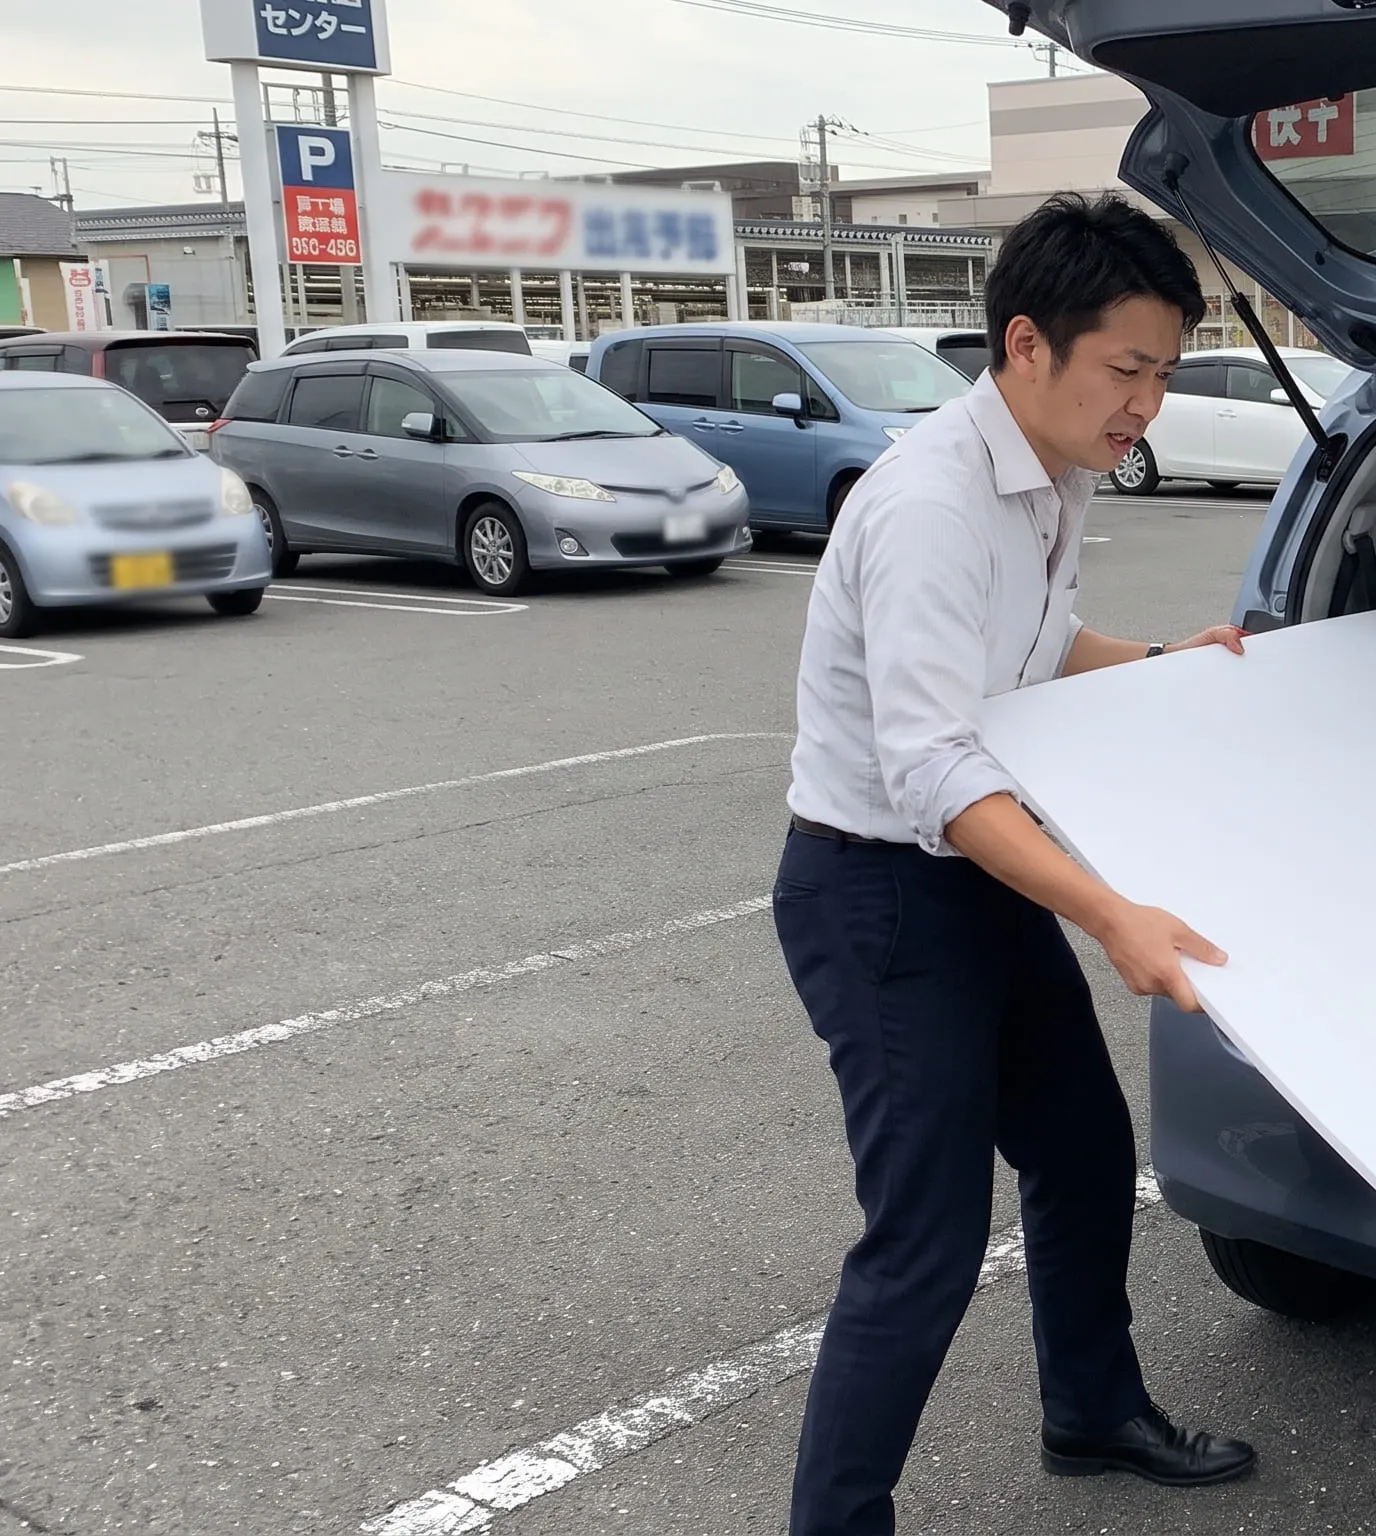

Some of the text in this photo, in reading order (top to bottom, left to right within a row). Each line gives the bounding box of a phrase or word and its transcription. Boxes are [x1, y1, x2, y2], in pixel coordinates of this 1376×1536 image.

[260, 3, 367, 40] センター
[297, 135, 336, 181] P
